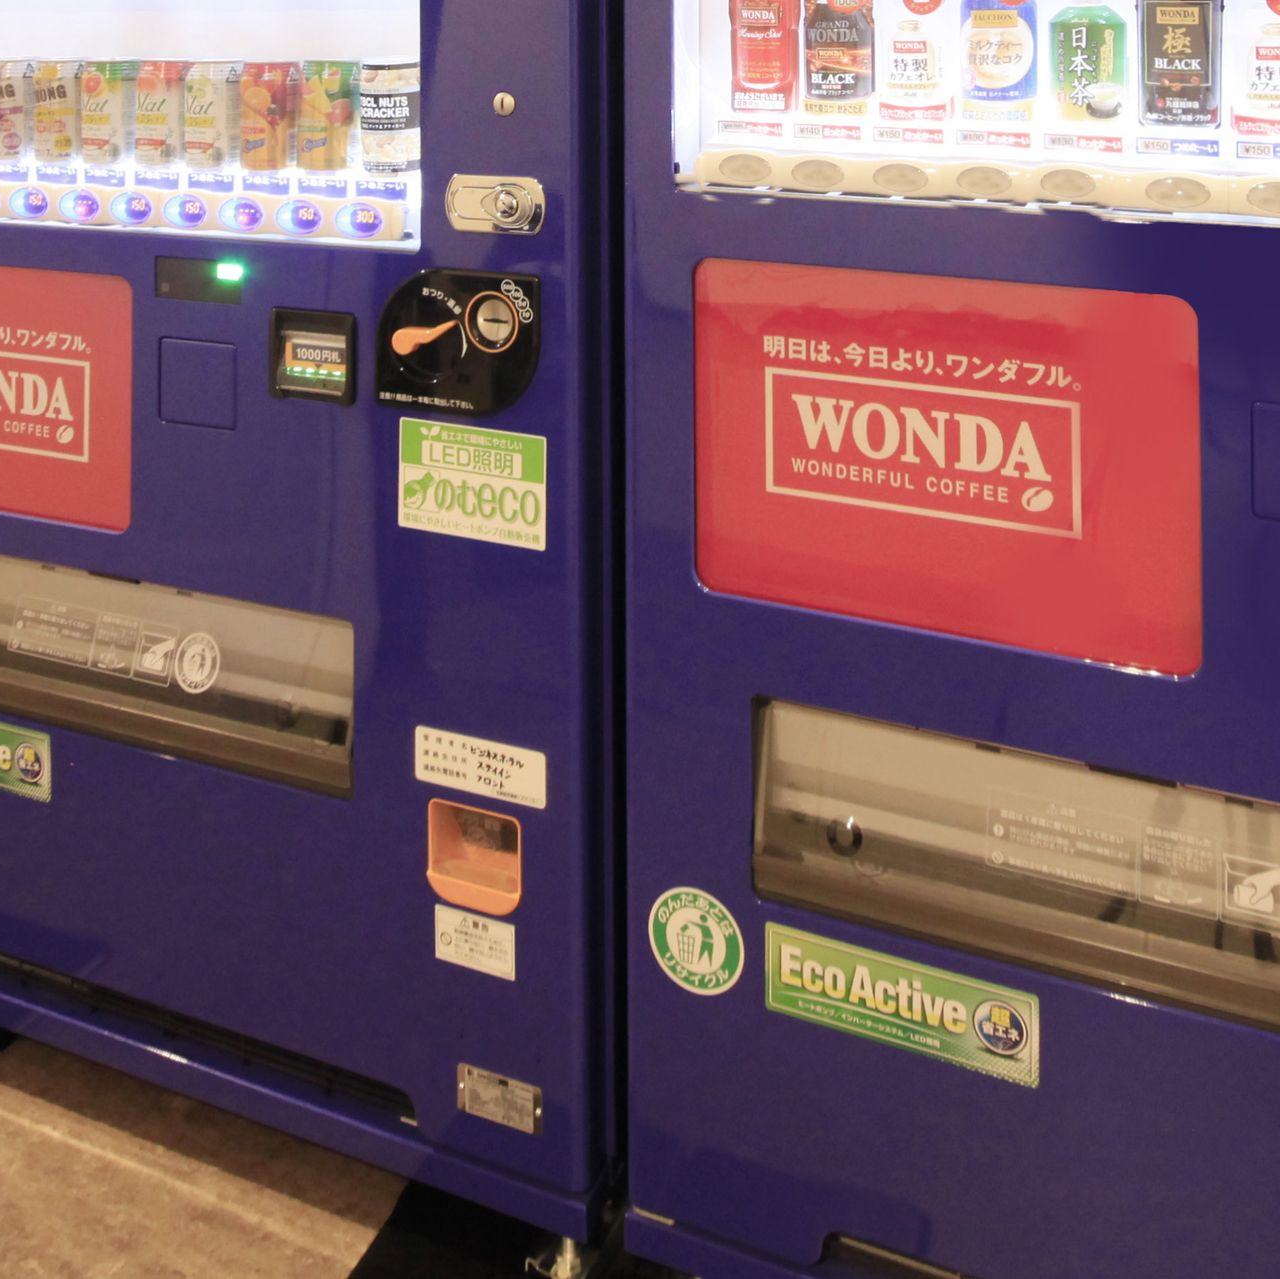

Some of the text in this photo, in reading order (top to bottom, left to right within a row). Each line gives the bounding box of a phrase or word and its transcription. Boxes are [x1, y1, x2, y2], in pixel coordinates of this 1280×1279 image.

[741, 9, 775, 20] WONDA
[1159, 9, 1197, 19] WONDA
[815, 20, 849, 29] GRAND
[807, 28, 860, 43] WONDA
[967, 39, 1024, 52] ミルクティー
[1162, 26, 1193, 54] 極
[893, 58, 929, 73] 特製
[1068, 26, 1095, 107] 日本茶
[1153, 57, 1201, 70] BLACK
[811, 73, 856, 84] BLACK
[888, 71, 934, 82] カフェオレ
[379, 96, 408, 107] NUTS
[295, 347, 341, 364] 1000円札
[762, 334, 1082, 392] 明日は、今日より、ワンダフル。
[4, 419, 51, 439] COFFEE
[791, 392, 1053, 483] WONDA
[429, 442, 515, 477] LED照明
[791, 456, 1010, 504] WONDERFUL COFFEE
[434, 478, 541, 527] のむeco
[657, 892, 734, 939] のんだあとは
[662, 951, 730, 989] リサイクル
[990, 1004, 1011, 1028] 超
[982, 1020, 1022, 1043] 省エネ
